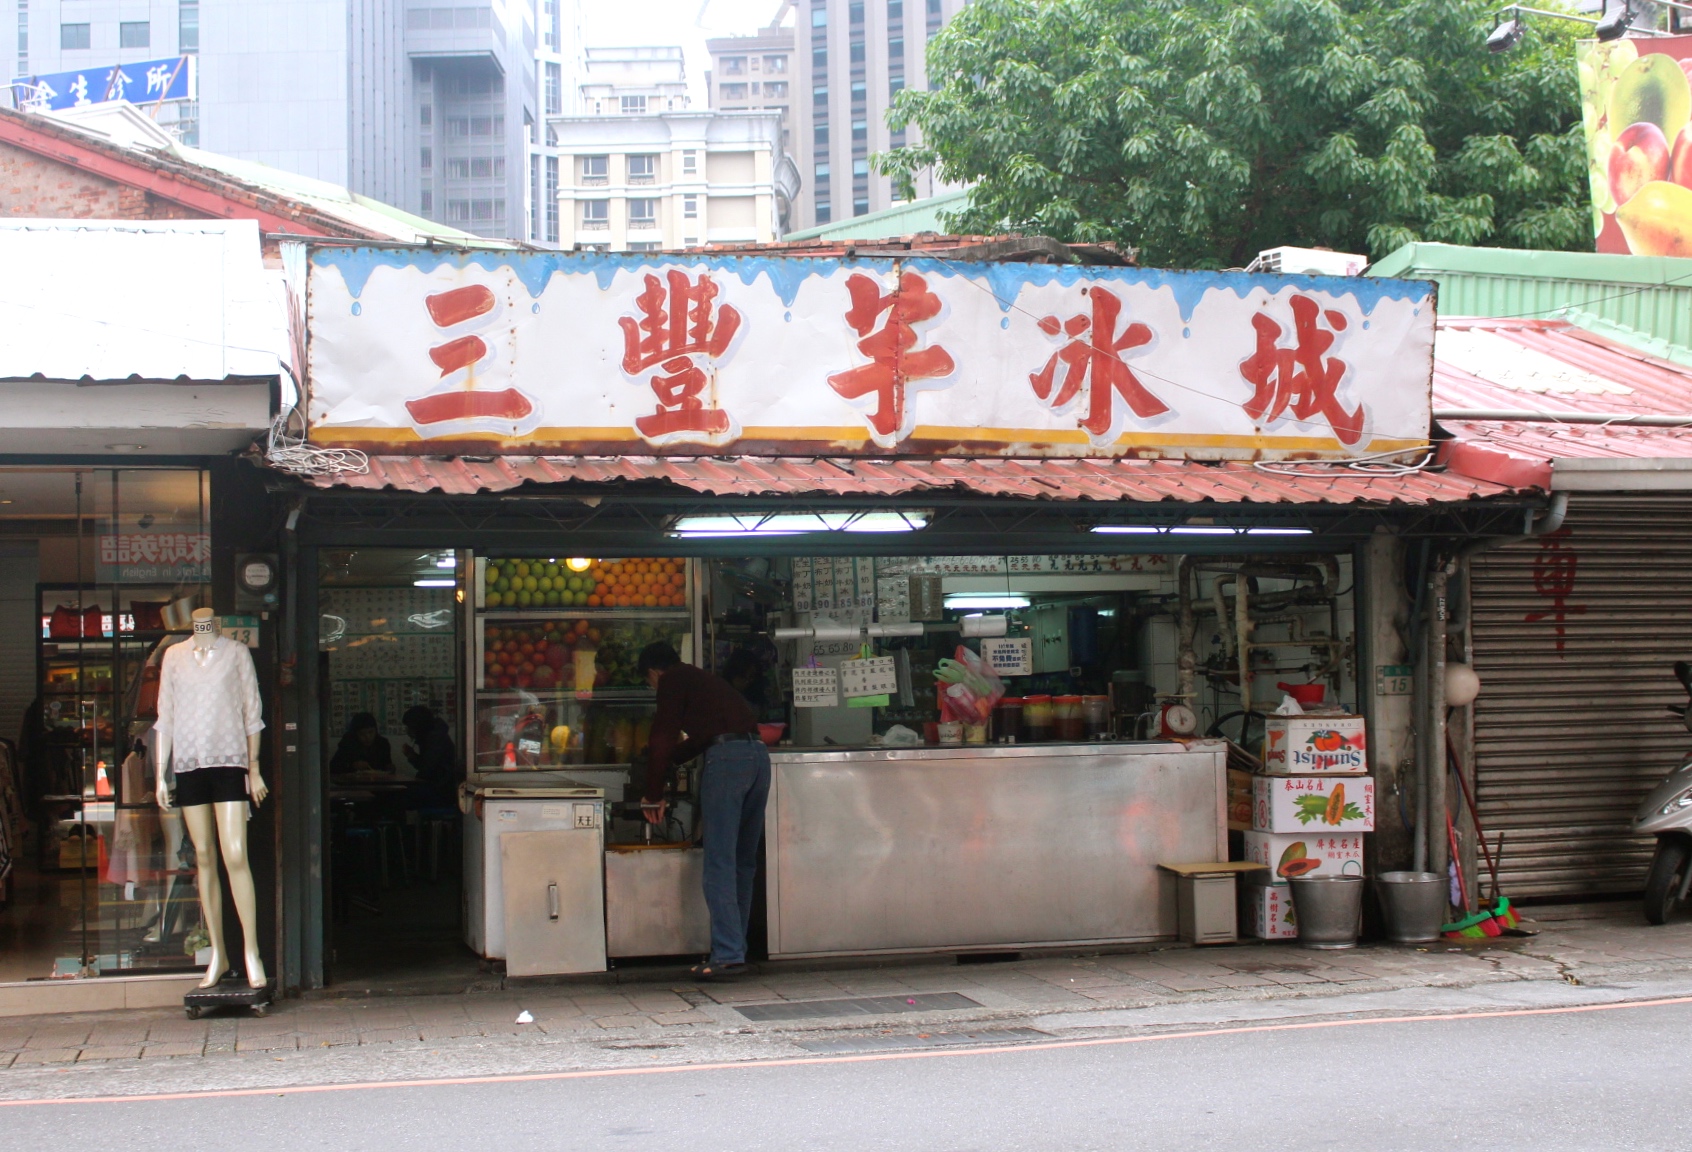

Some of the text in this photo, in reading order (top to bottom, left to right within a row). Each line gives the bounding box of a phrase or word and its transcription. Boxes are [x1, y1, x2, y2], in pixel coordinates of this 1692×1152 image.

[404, 269, 1365, 446] 三豐芋冰城
[797, 601, 809, 609] 90
[817, 600, 829, 608] 90
[194, 623, 212, 632] 590
[231, 629, 251, 645] 13
[1391, 678, 1407, 692] 15
[1293, 750, 1361, 770] Sunkist
[1285, 779, 1324, 791] 泰山名產
[1316, 838, 1360, 850] 屏東名產
